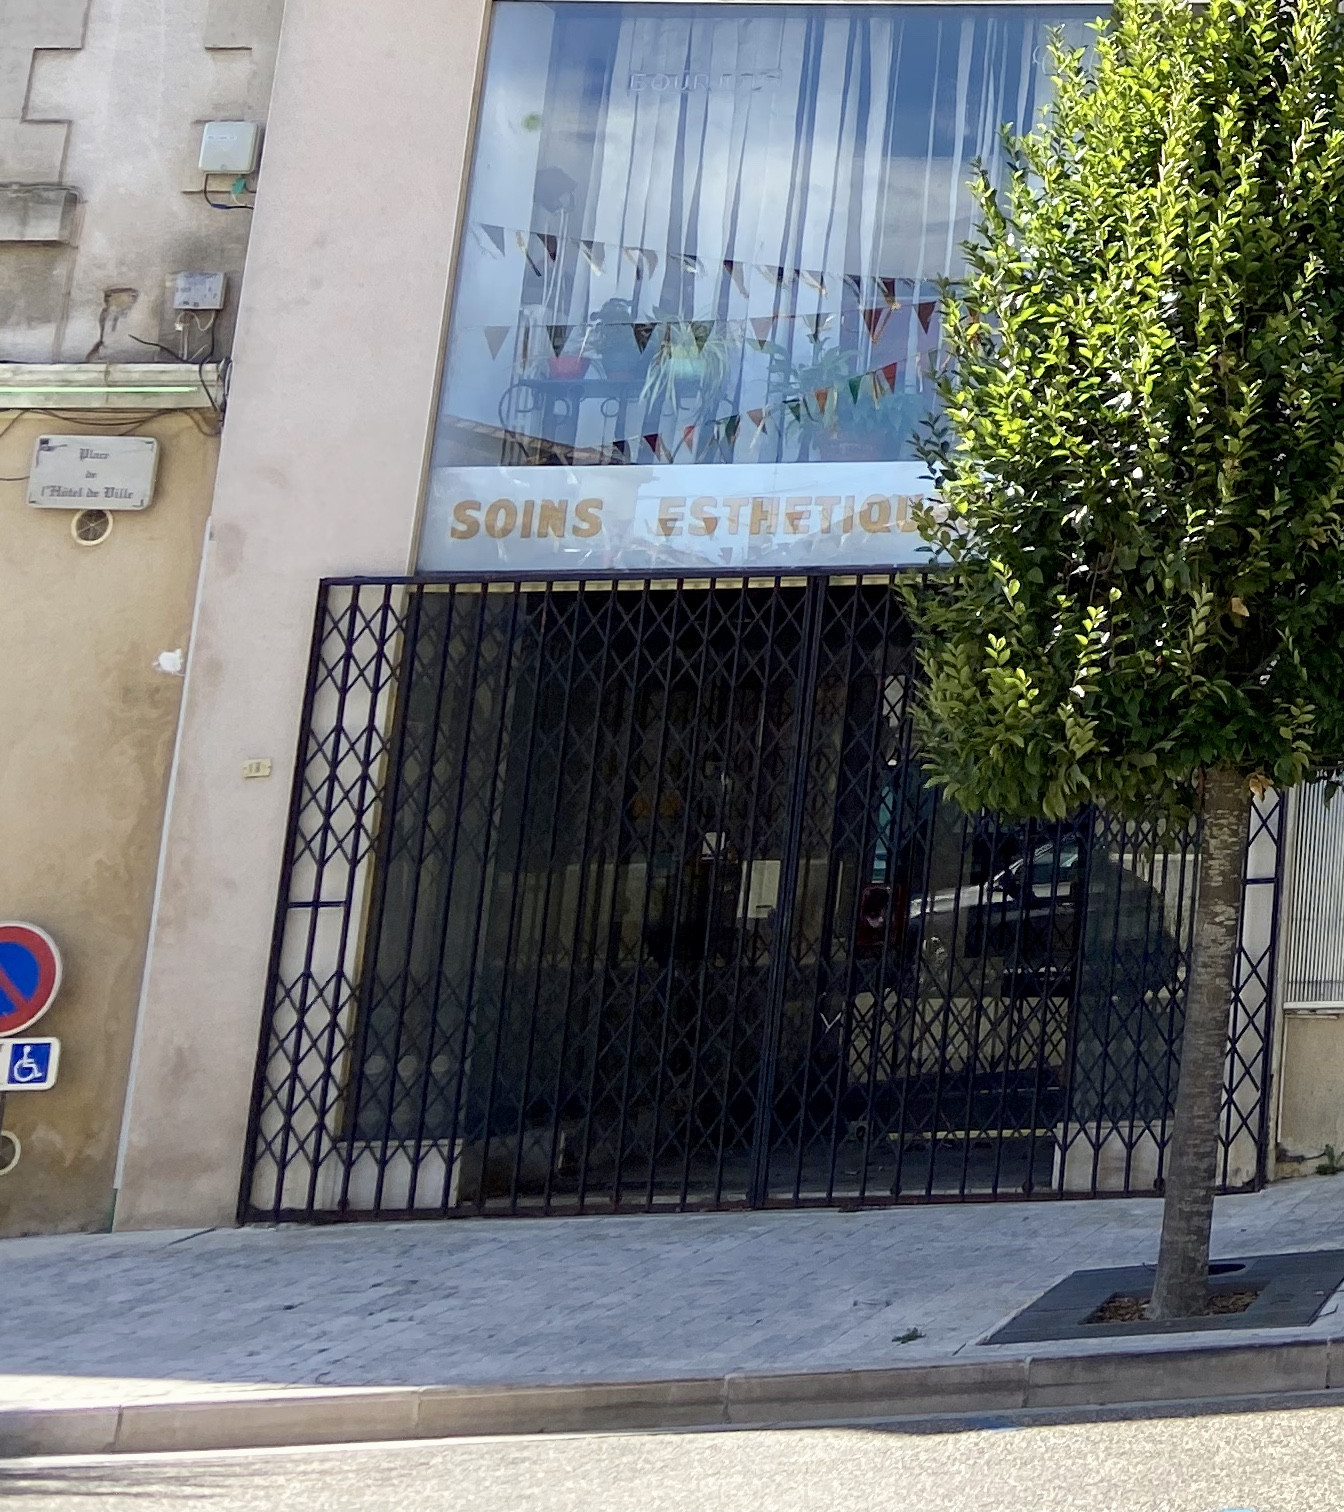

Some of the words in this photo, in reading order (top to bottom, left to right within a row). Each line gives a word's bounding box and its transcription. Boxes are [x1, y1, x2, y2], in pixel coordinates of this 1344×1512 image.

[86, 488, 99, 498] de
[104, 487, 133, 499] Ville
[450, 498, 604, 539] SOINS
[656, 494, 924, 537] ESTHETIQU
